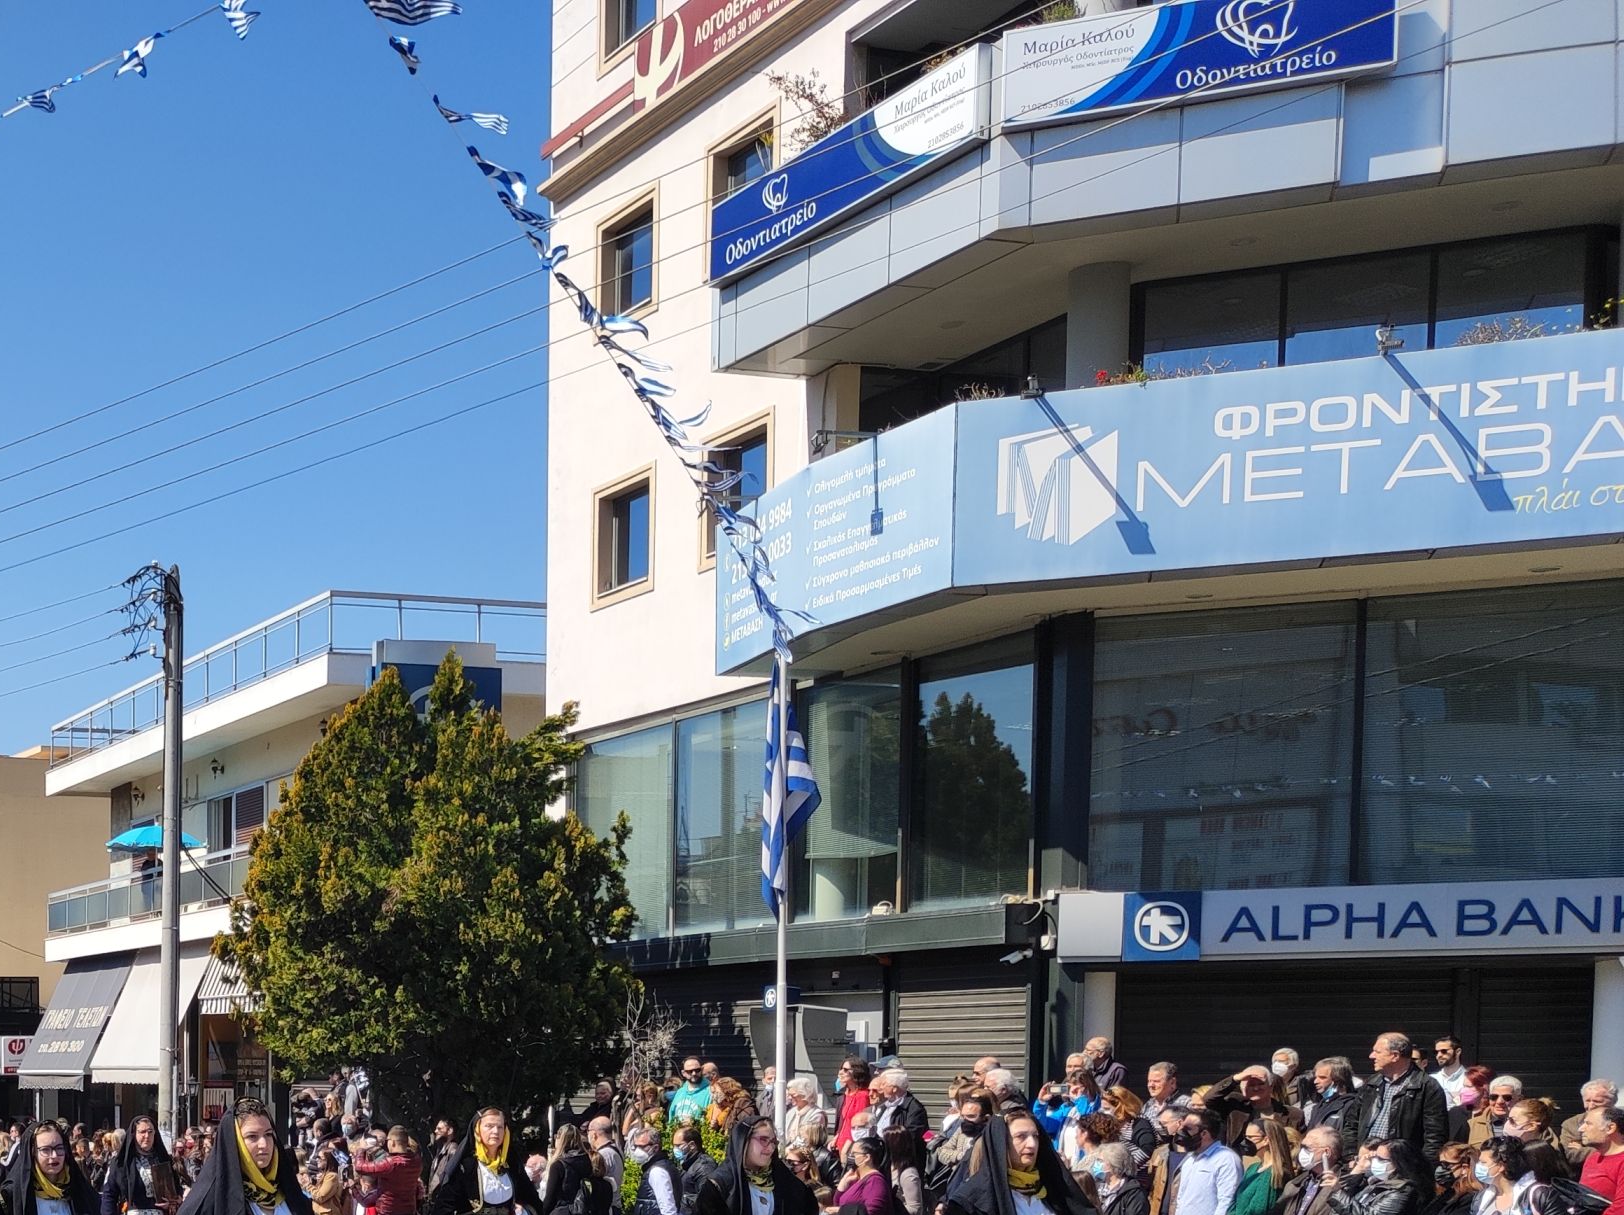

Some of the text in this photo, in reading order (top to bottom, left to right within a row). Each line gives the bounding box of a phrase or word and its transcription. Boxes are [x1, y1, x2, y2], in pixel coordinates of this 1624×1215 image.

[713, 33, 727, 53] 210
[727, 25, 736, 43] 28
[737, 18, 747, 35] 30
[747, 7, 762, 27] 100
[1022, 23, 1135, 56] Μαρία Καλού
[1075, 45, 1135, 61] Οδοντίατρος
[1175, 46, 1337, 90] Οδοντιατρείο
[894, 89, 929, 119] Μαρία
[931, 62, 967, 98] Καλού
[725, 200, 817, 265] Οδοντιατρείο
[1214, 366, 1624, 440] ΦΡΟΝΤΙΣΤΗ
[814, 470, 854, 494] Ολιγομελή
[1513, 478, 1581, 514] πλάι
[768, 497, 793, 531] 9984
[814, 489, 861, 516] Οργανωμένα
[813, 510, 848, 531] Σπουδών
[768, 531, 792, 564] 0033
[813, 536, 879, 568] Προσανατολισμός
[892, 536, 940, 561] περιβάλλον
[902, 562, 922, 580] Τιμές
[1220, 896, 1624, 943] ALPHA BAN
